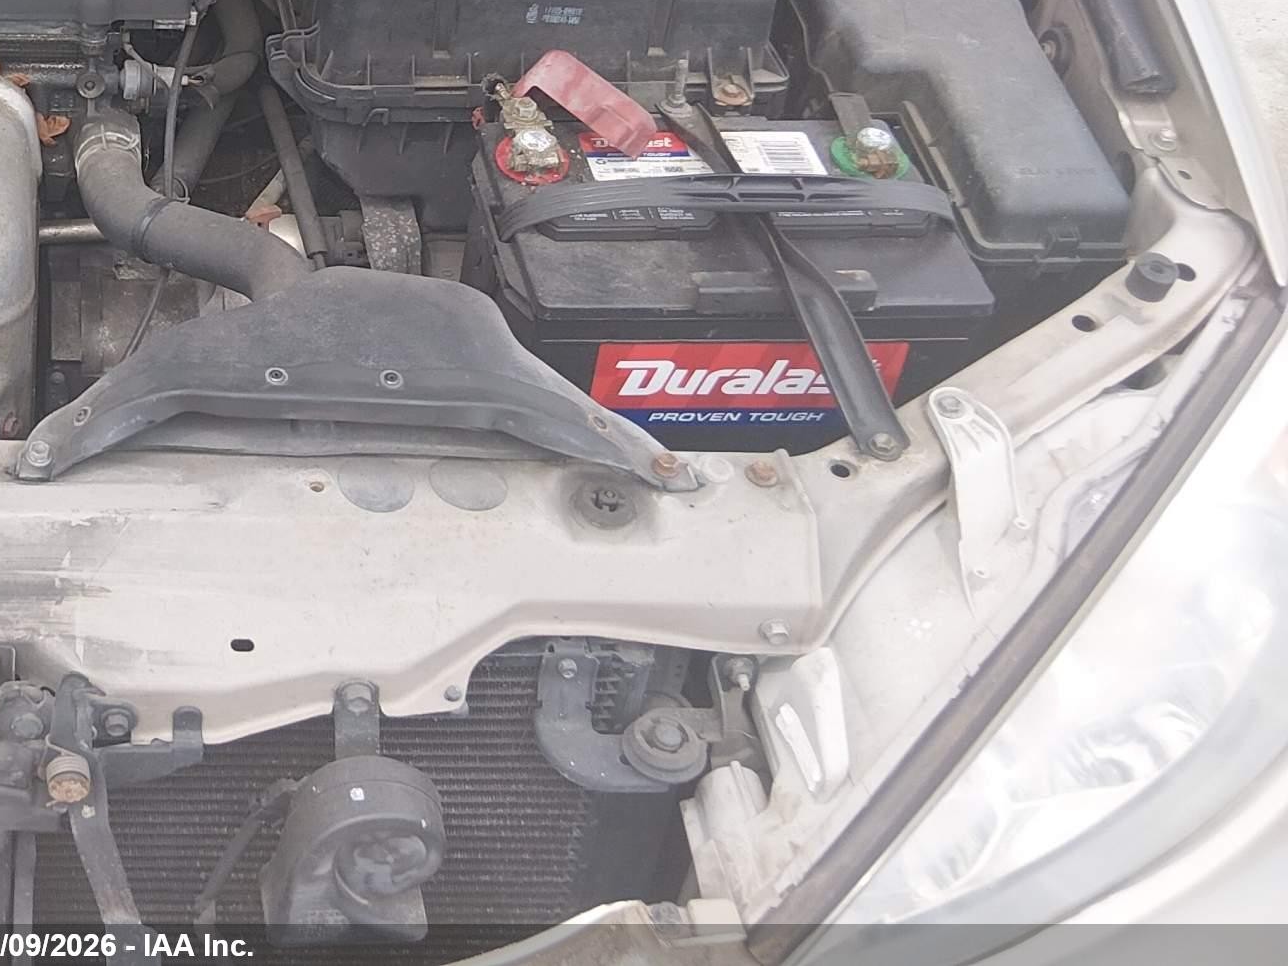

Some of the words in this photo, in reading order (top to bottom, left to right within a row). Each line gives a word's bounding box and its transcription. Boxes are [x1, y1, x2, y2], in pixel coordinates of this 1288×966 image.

[615, 359, 831, 395] Durala
[647, 411, 742, 423] PROVEN
[748, 411, 826, 423] TOUGH
